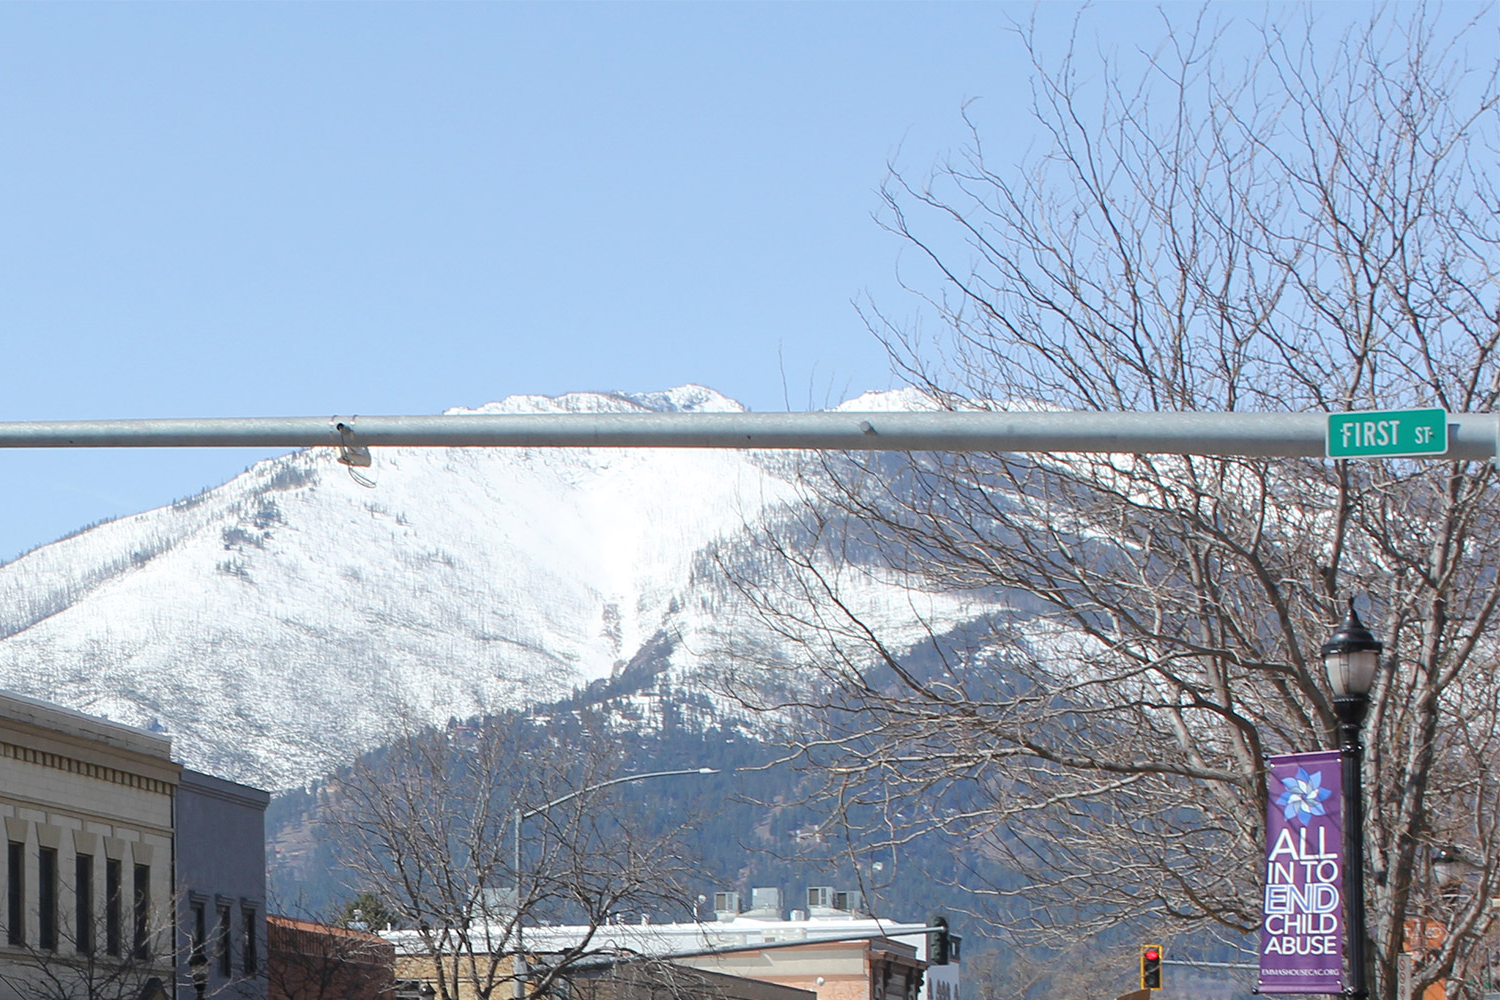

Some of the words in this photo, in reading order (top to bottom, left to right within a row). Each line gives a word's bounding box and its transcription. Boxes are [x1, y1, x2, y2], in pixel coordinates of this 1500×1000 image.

[1342, 420, 1400, 448] FIRST
[1414, 426, 1433, 445] ST
[1268, 826, 1338, 861] ALL
[1267, 861, 1294, 884] IN
[1300, 859, 1339, 883] TO
[1264, 883, 1340, 914] END
[1265, 913, 1338, 935] CHILD
[1263, 935, 1337, 955] ABUSE
[1261, 967, 1340, 977] EMMASHOUSECAC.ORG
